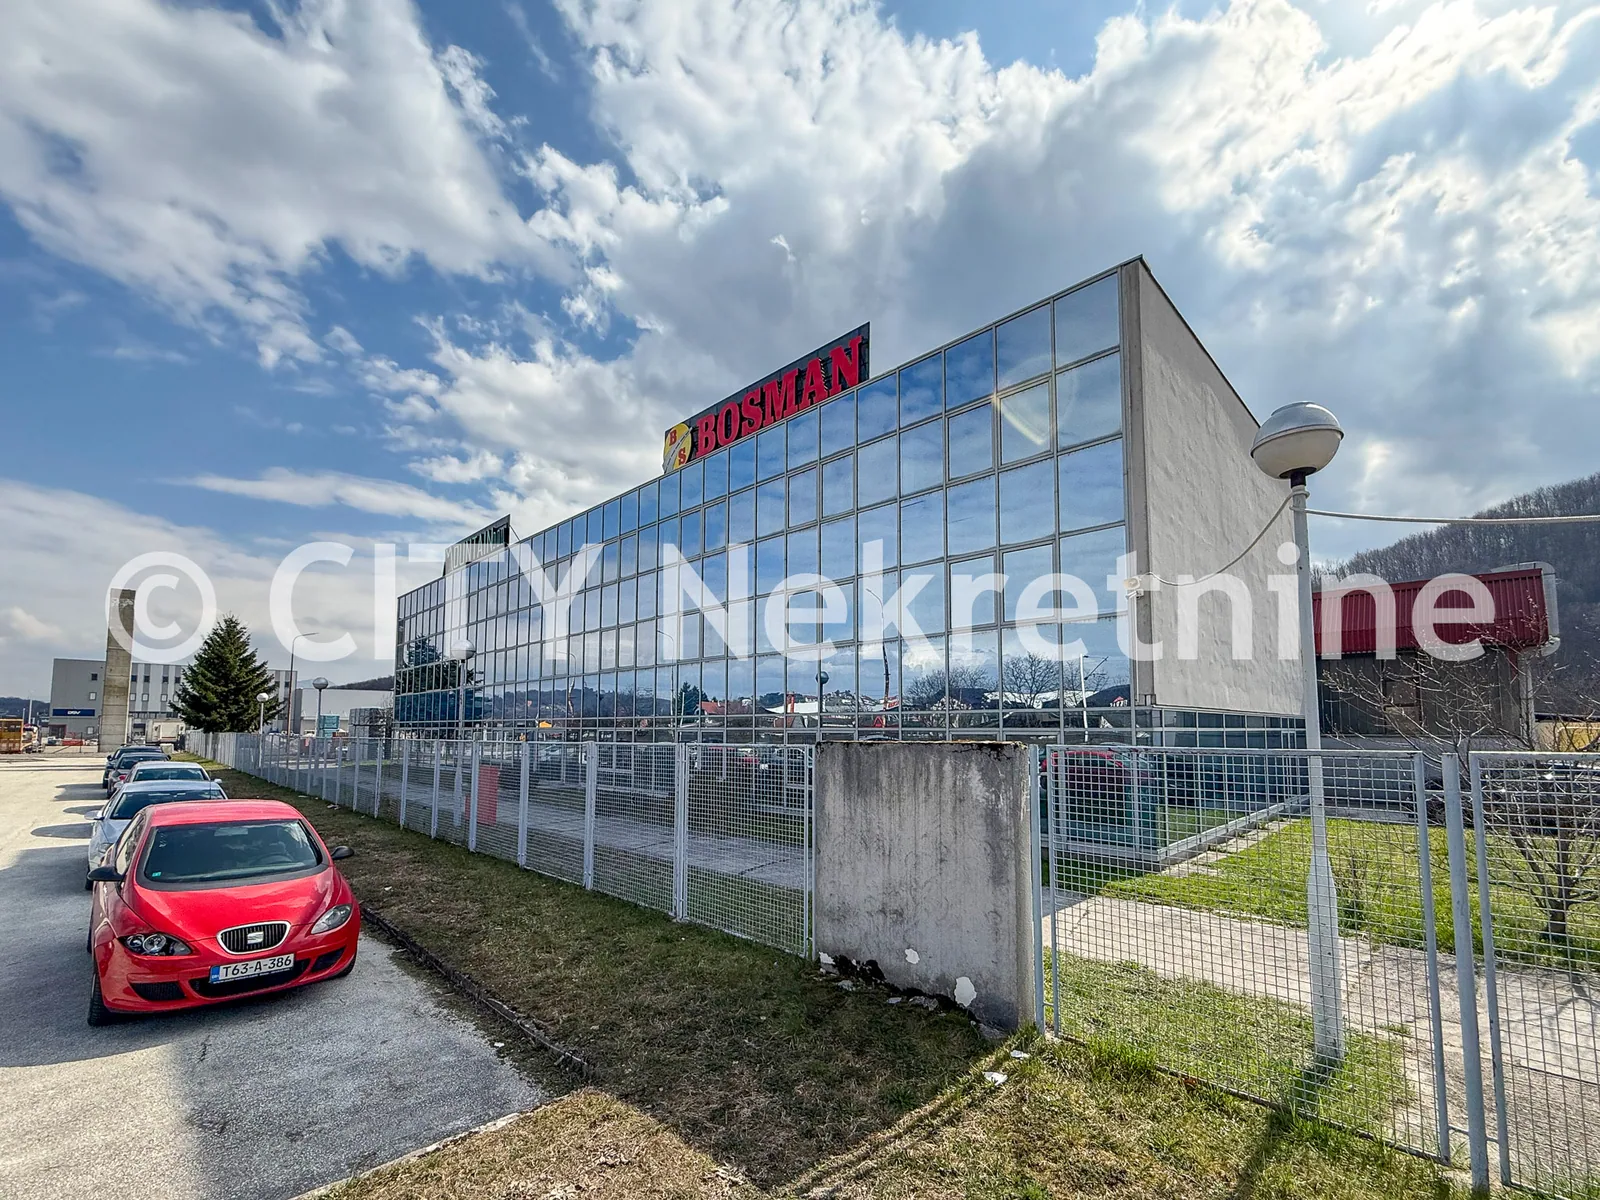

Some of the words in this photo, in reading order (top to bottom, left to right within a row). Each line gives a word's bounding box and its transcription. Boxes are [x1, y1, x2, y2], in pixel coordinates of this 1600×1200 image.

[696, 335, 862, 458] BOSMAN
[669, 429, 677, 446] B
[678, 447, 687, 466] S
[222, 955, 292, 978] T63-A-386
